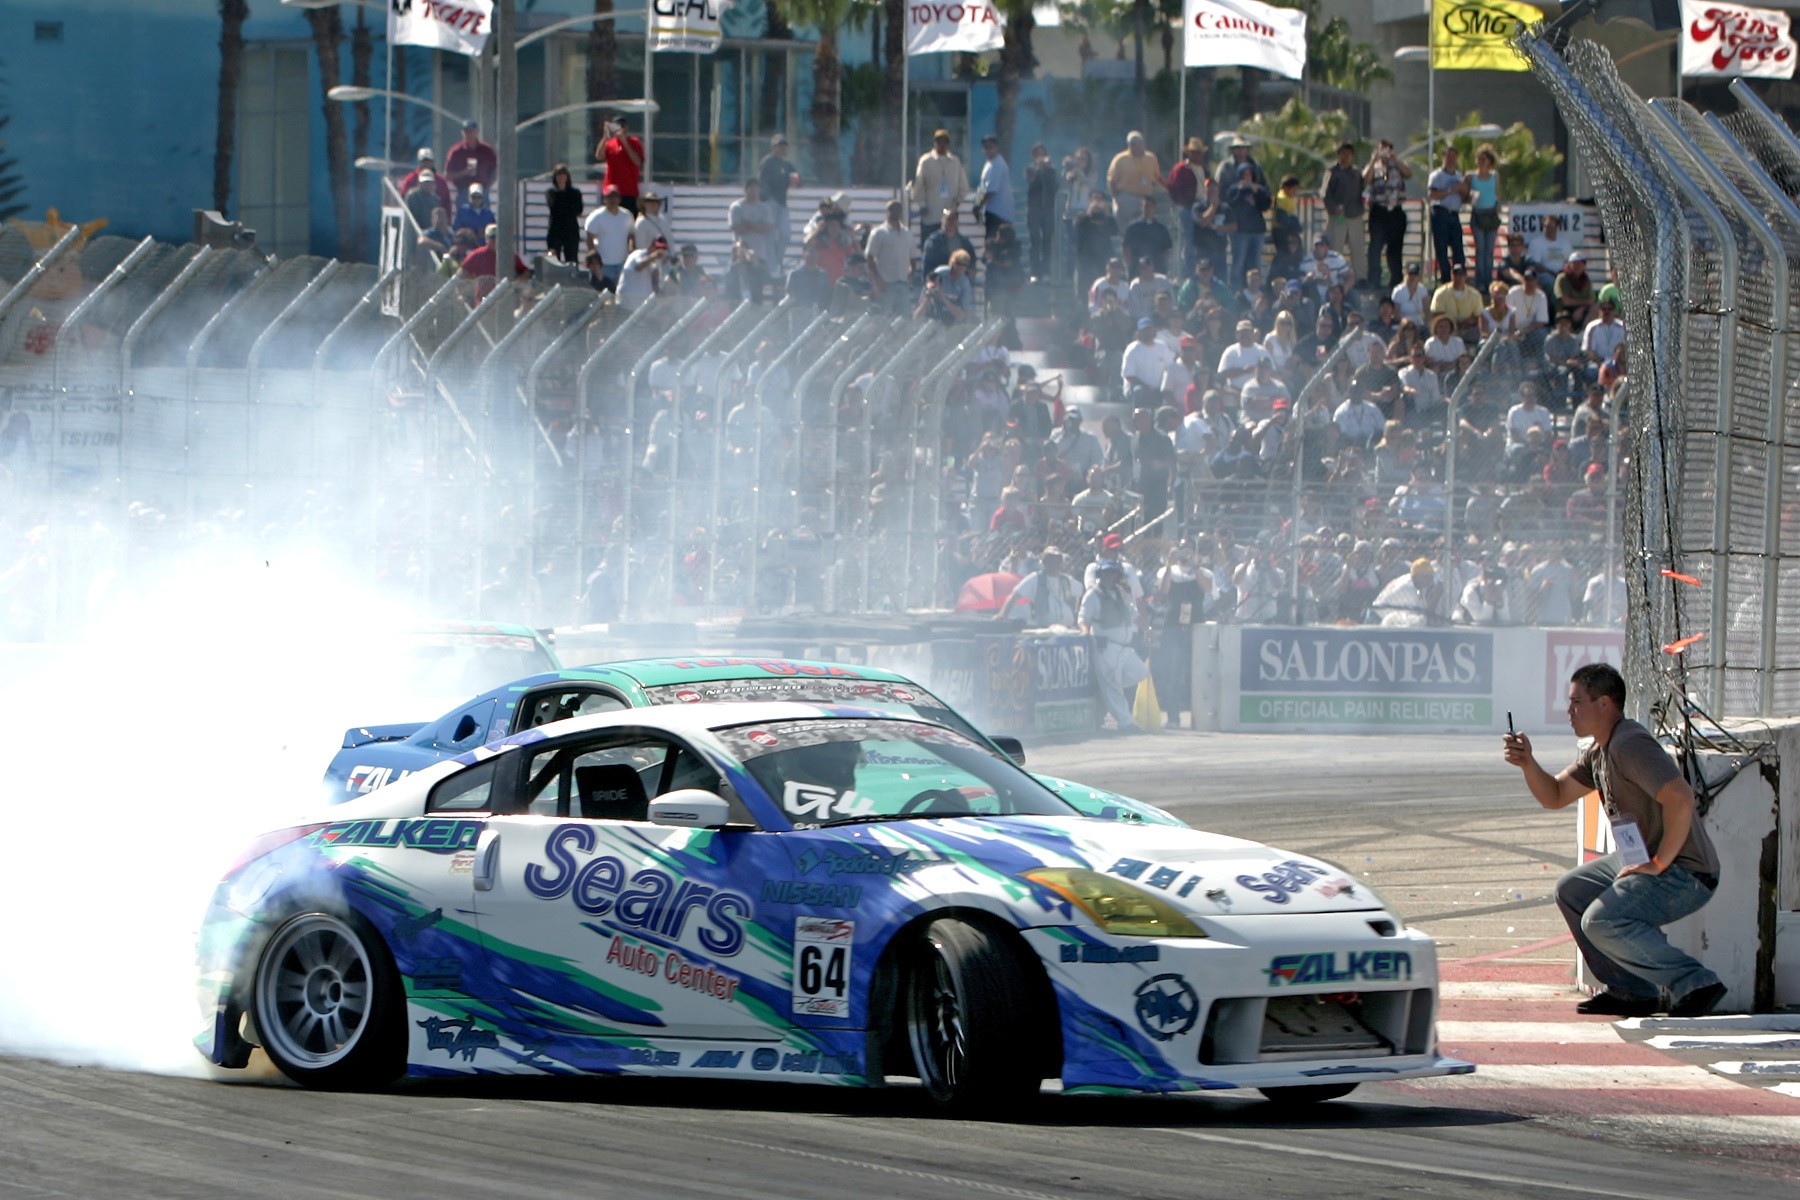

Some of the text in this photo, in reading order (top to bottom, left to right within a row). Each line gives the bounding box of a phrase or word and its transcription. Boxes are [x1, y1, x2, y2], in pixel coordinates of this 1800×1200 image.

[911, 4, 999, 26] TOYOTA
[1194, 11, 1275, 37] Canon
[1690, 8, 1779, 43] King
[1712, 34, 1790, 71] Taco
[1512, 213, 1581, 232] SECTN 2
[1258, 638, 1478, 684] SALONPAS
[1258, 698, 1476, 721] OFFICIAL PAIN RELIEVER
[524, 823, 754, 957] Sears
[760, 879, 863, 909] NISSAN
[606, 936, 740, 1001] Auto Center
[800, 945, 846, 997] 64
[1262, 951, 1412, 987] FALKEN
